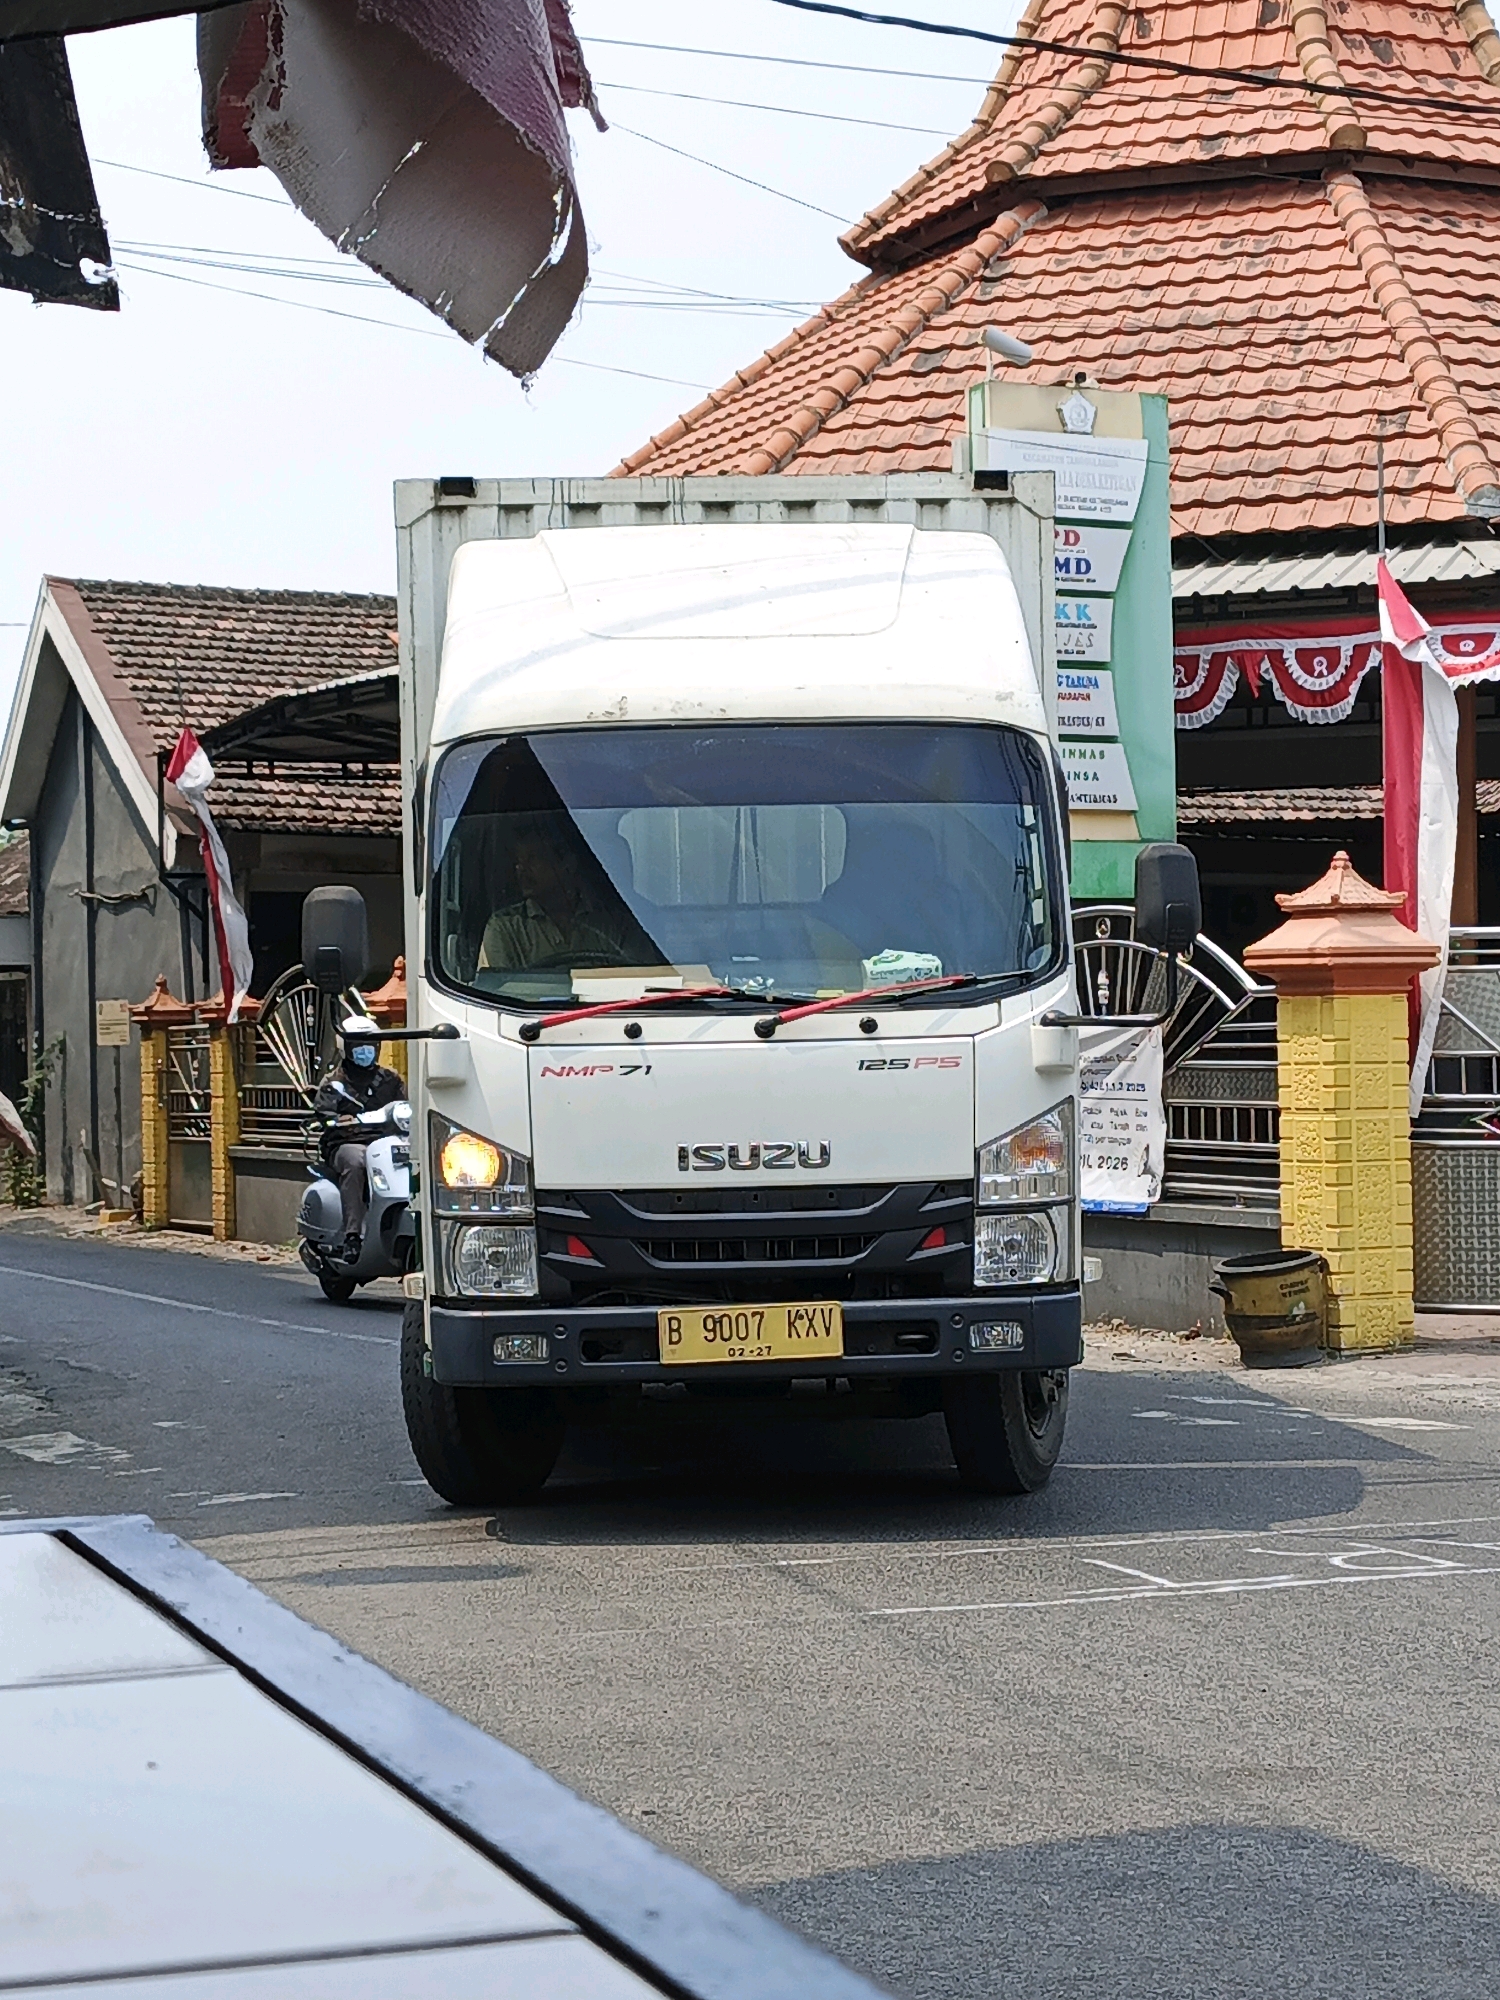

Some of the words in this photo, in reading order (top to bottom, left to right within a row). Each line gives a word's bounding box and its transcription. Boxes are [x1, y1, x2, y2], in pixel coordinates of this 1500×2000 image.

[1067, 771, 1100, 782] INSA
[857, 1058, 911, 1071] 125
[913, 1056, 963, 1070] PS
[677, 1140, 831, 1171] ISUZU
[1080, 1154, 1093, 1169] IL
[1097, 1155, 1129, 1171] 2026
[667, 1316, 683, 1346] B
[702, 1311, 765, 1343] 9007
[787, 1307, 833, 1339] KXV
